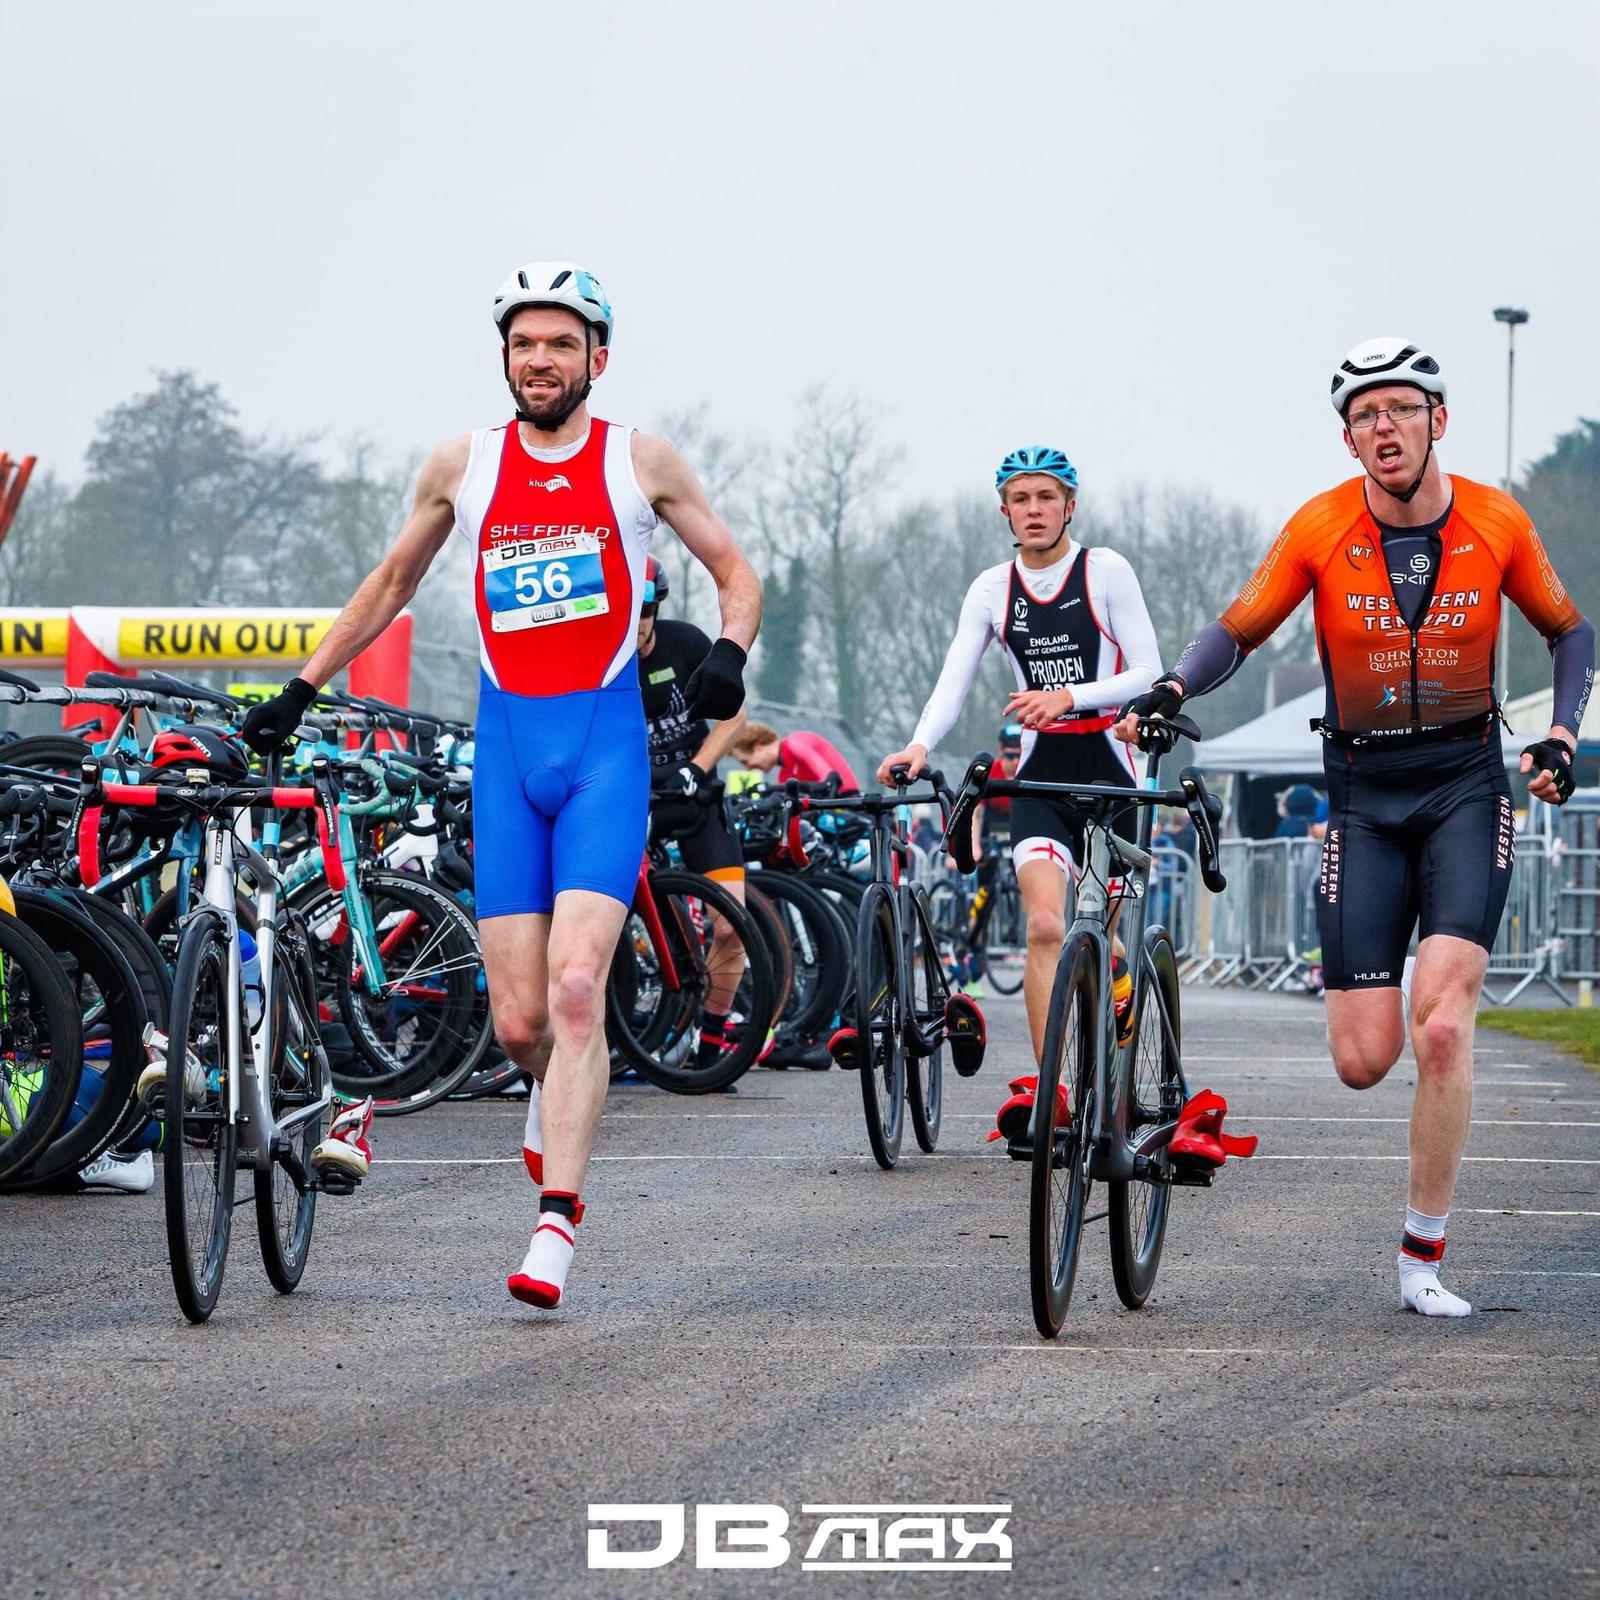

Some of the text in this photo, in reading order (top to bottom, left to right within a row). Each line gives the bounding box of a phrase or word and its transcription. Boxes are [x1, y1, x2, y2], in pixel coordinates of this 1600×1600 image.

[490, 524, 611, 540] SHEFFIELD
[501, 538, 577, 561] DB MAX
[514, 561, 573, 605] 56
[1347, 590, 1480, 611] WESTERN
[1364, 613, 1467, 631] TEMPO
[144, 622, 315, 654] RUN OUT
[1030, 634, 1070, 647] ENGLAND
[1025, 643, 1079, 655] NEXT GENERATION
[1369, 648, 1459, 663] JOHNSTON
[1029, 656, 1085, 684] PRIDDEN
[1423, 658, 1459, 667] GROUP
[1496, 795, 1511, 870] WESTERN
[1320, 842, 1330, 895] TEMPO
[1328, 829, 1339, 904] WESTERN
[1354, 971, 1390, 981] HUUB
